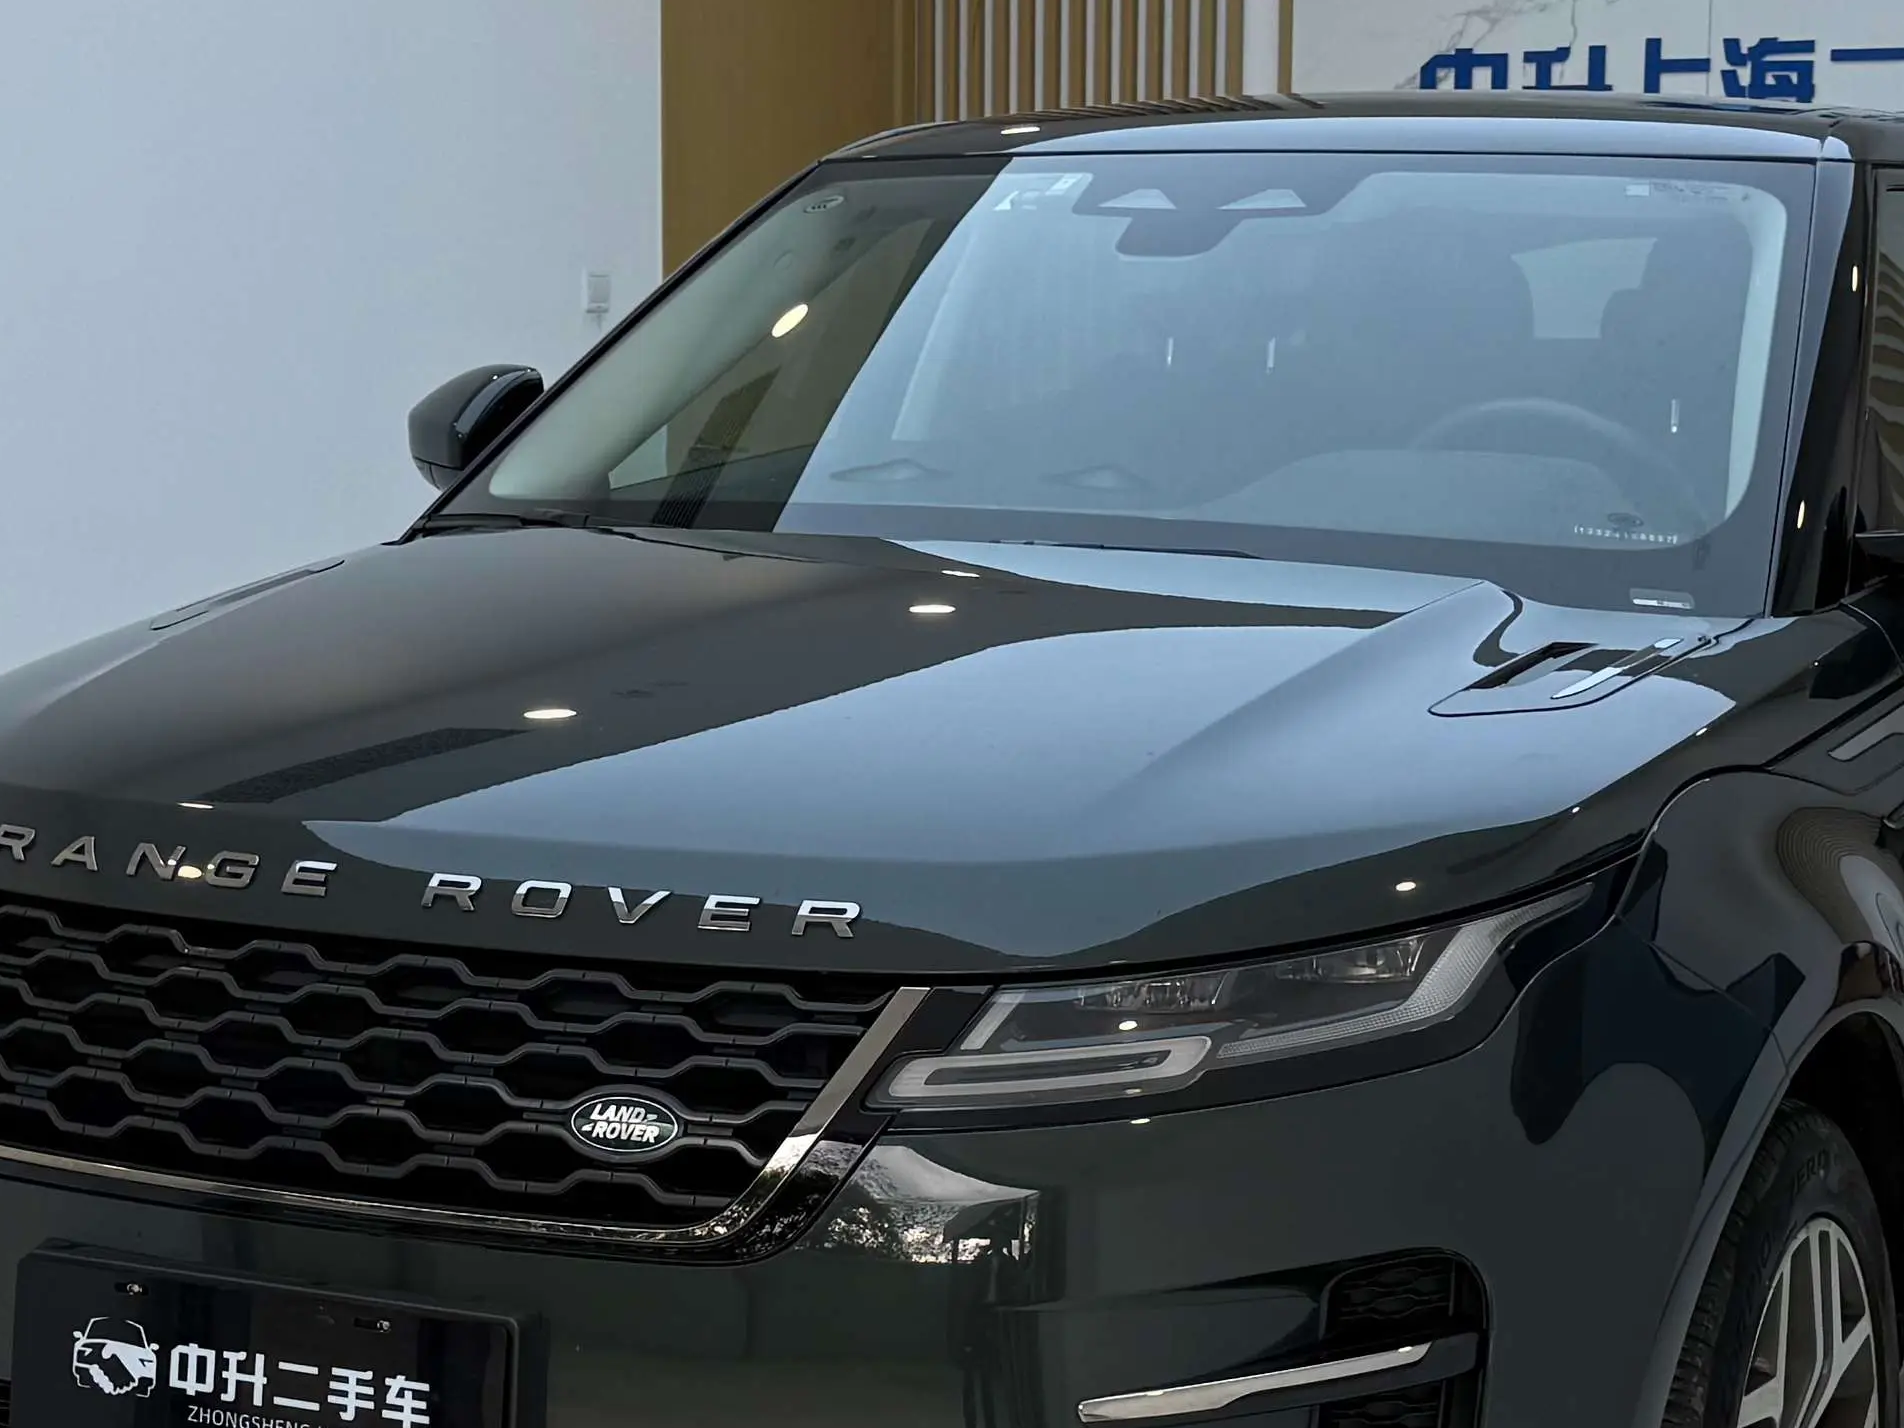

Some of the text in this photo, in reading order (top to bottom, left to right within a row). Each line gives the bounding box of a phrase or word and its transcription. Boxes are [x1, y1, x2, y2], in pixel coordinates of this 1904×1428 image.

[420, 871, 864, 939] ROVER
[589, 1103, 647, 1125] LAND
[591, 1120, 661, 1144] ROVER
